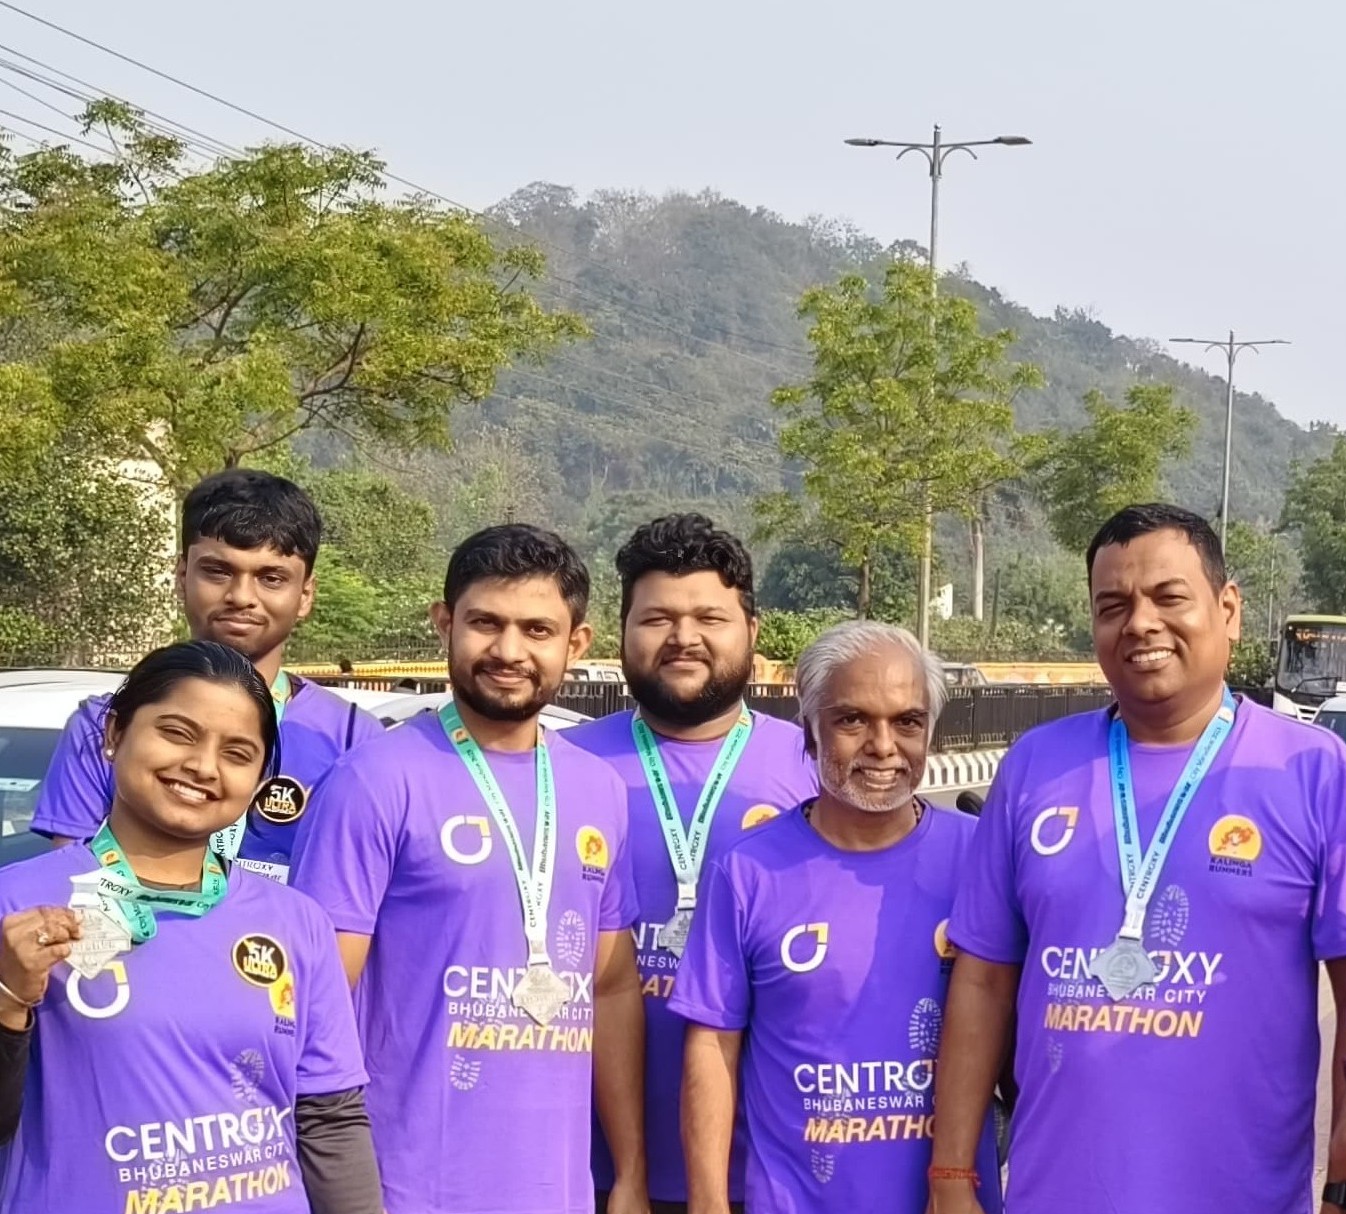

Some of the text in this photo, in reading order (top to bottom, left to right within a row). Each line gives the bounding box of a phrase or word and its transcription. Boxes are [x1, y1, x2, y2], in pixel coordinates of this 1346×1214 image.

[270, 784, 295, 802] 5K
[670, 828, 687, 870] CENTROXY
[1210, 855, 1252, 869] KALINGA
[1136, 851, 1161, 899] CENTROXY
[1208, 863, 1254, 877] RUNNERS
[251, 944, 276, 962] 5K
[1041, 945, 1223, 986] CENOXY
[1048, 983, 1206, 1004] BHUBANEAR CITY
[1044, 1004, 1204, 1038] MARATHON
[447, 1022, 594, 1053] MARATHON
[794, 1059, 937, 1094] CENTRO
[805, 1095, 924, 1110] BHUBANESWAR
[105, 1105, 292, 1163] CENTROXY
[119, 1141, 290, 1183] BHUBANESWAR CIT
